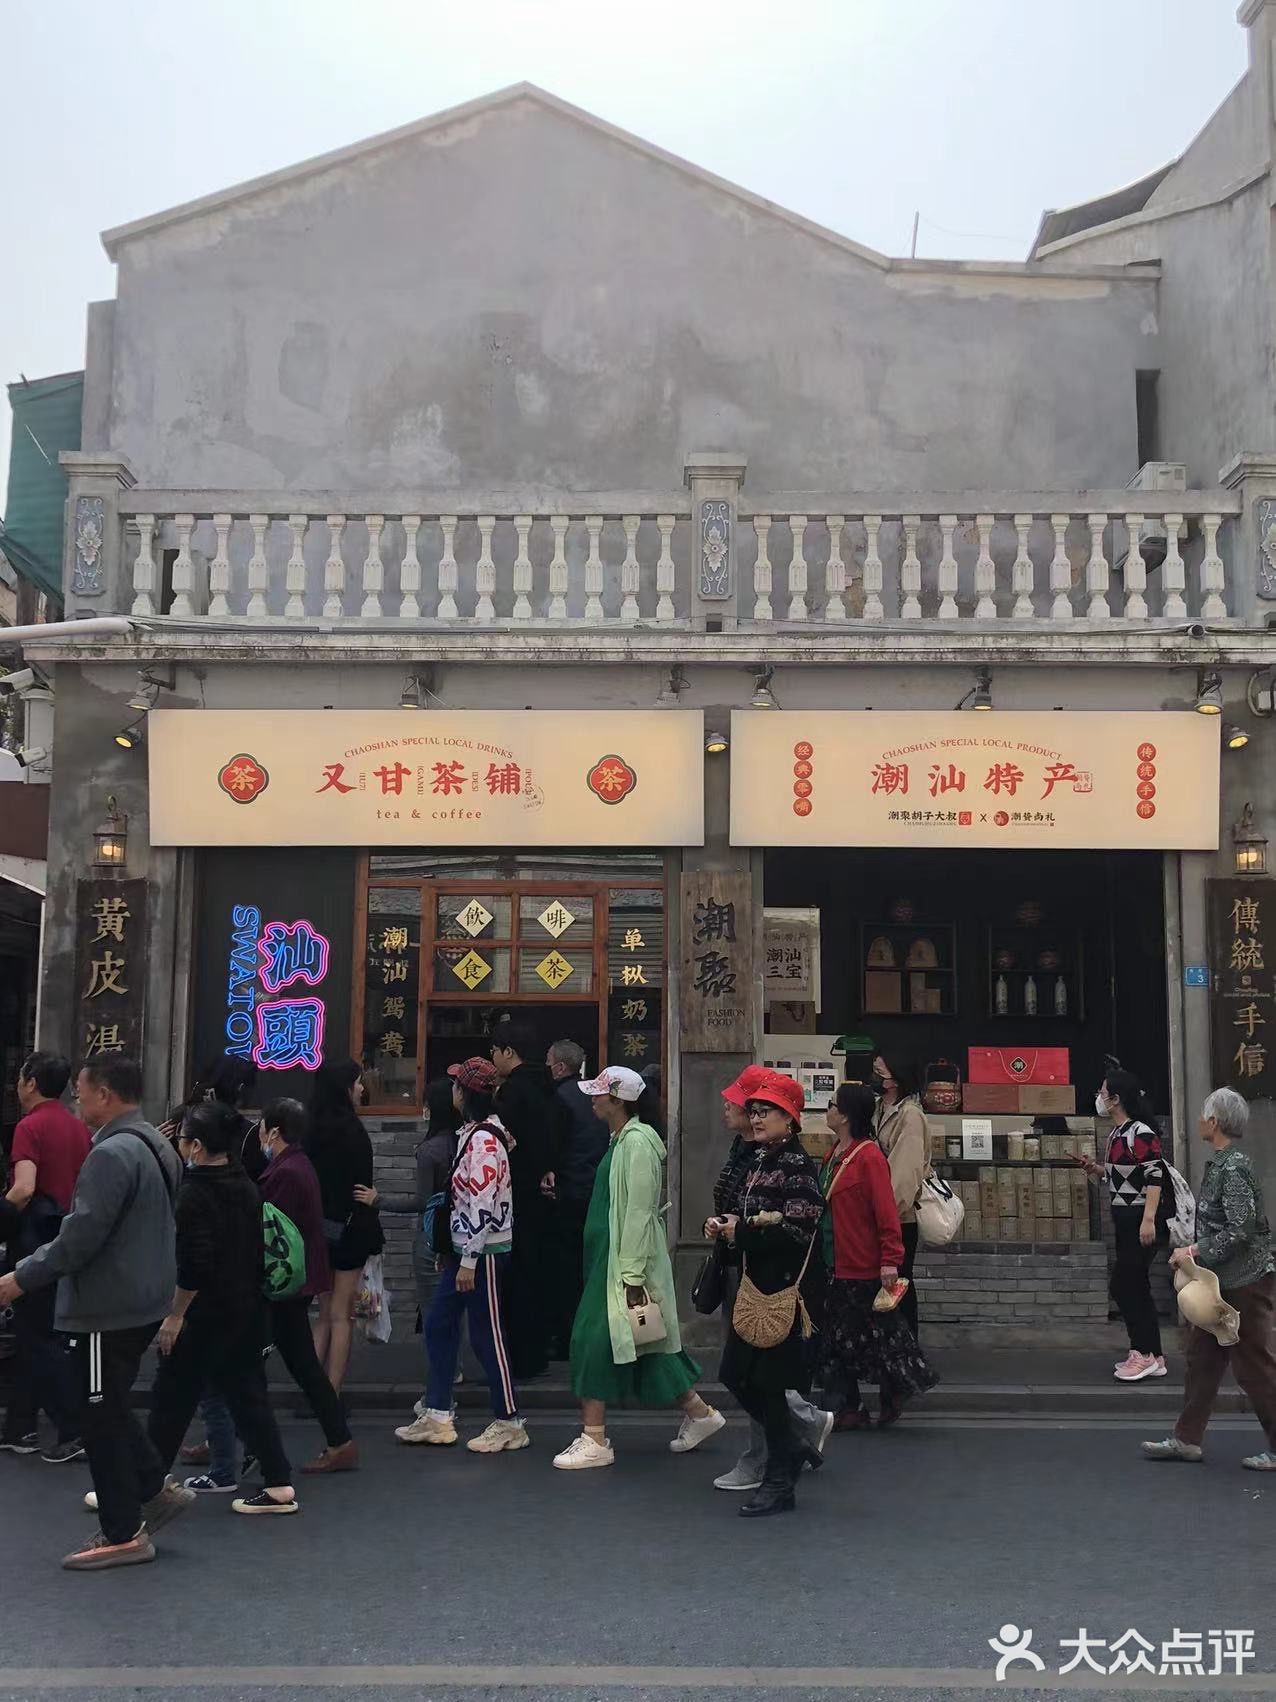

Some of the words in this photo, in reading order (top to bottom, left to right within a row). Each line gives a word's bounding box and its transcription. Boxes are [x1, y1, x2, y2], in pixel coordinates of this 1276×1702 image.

[344, 739, 399, 758] CHAOSHAN
[402, 737, 440, 746] SPECIAL
[443, 737, 474, 749] LOCAL
[477, 742, 513, 759] DRINKS
[882, 740, 937, 760] CHAOSHAN
[940, 738, 979, 748] SPECIAL
[982, 738, 1013, 749] LOCAL
[1016, 742, 1063, 761] PRODUCT
[229, 765, 258, 791] 茶
[315, 760, 521, 797] 又甘茶铺
[599, 765, 627, 792] 茶
[870, 762, 1079, 801] 潮汕特产
[1138, 745, 1154, 817] 传统手信
[376, 808, 401, 819] tea
[411, 808, 421, 819] &
[432, 808, 482, 819] coffee
[888, 810, 957, 821] 潮聚胡子大叔
[546, 907, 567, 930] 啡
[766, 948, 801, 963] 潮汕
[459, 957, 484, 980] 食
[545, 957, 567, 980] 茶
[766, 964, 802, 980] 三宝
[380, 926, 408, 1058] 潮汕鸳鸯
[707, 1008, 745, 1018] FASHION
[707, 1018, 733, 1027] FOOD
